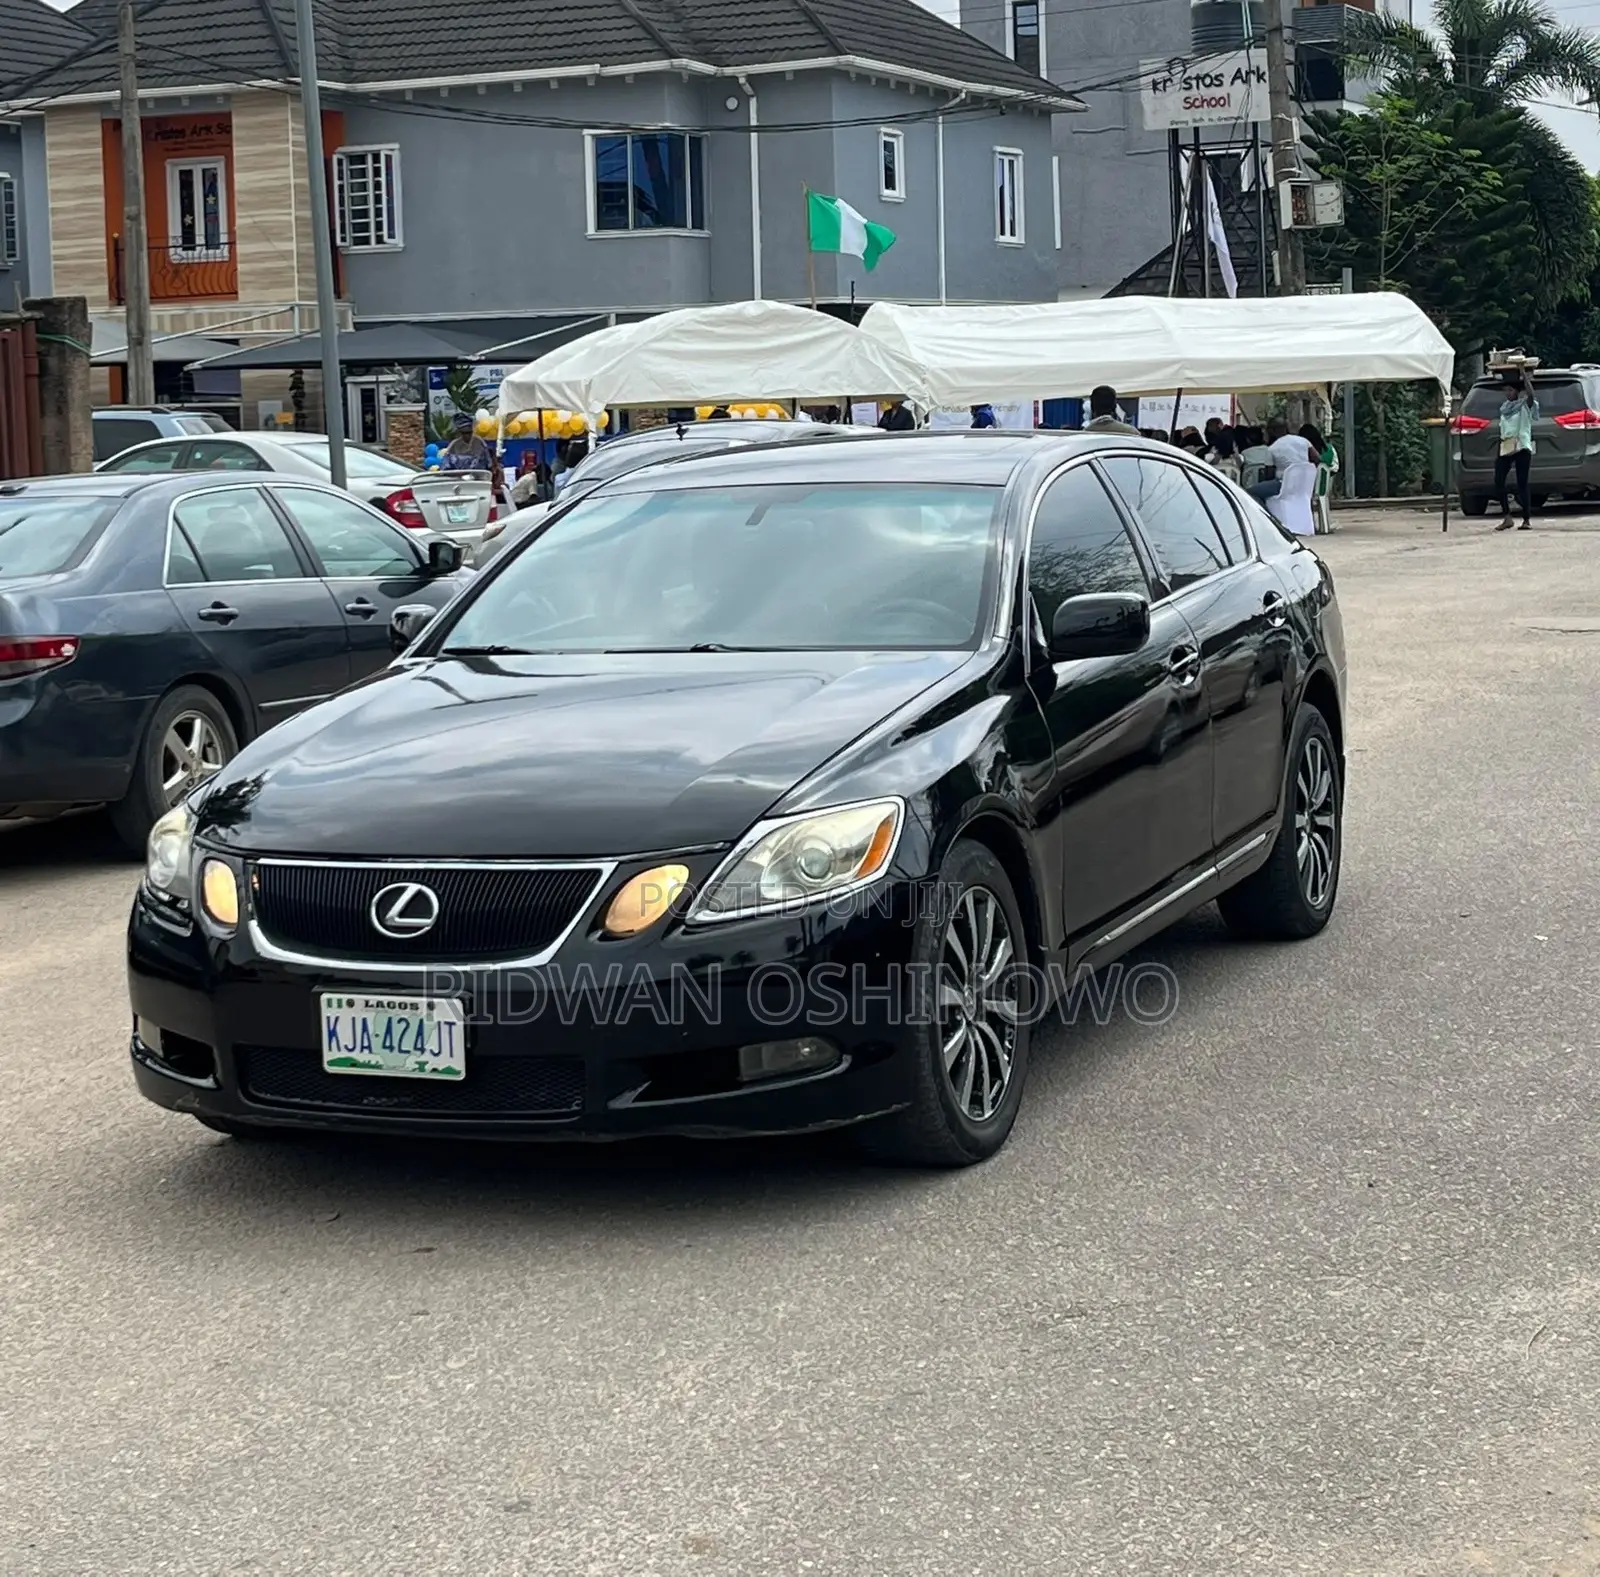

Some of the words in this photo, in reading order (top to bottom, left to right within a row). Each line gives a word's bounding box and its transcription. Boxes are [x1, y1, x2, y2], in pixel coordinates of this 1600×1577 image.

[1230, 65, 1267, 87] Ark
[1182, 93, 1231, 110] School
[364, 999, 420, 1011] LAGOS
